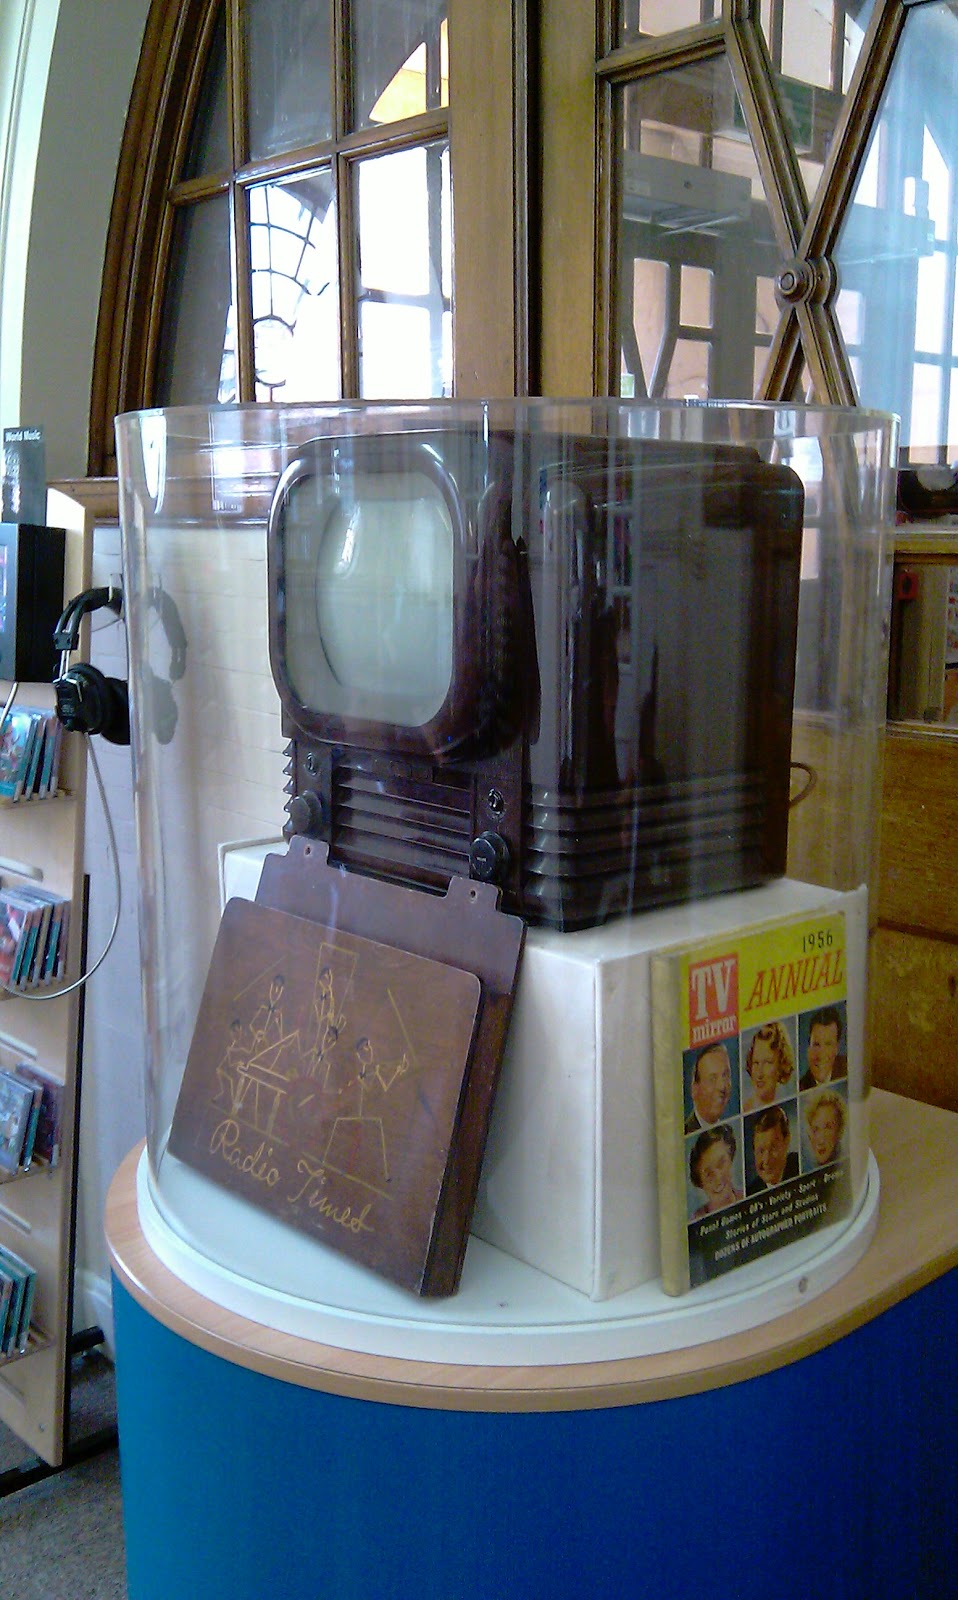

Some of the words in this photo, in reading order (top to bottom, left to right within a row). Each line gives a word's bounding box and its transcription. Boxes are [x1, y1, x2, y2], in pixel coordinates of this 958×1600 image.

[24, 430, 41, 440] Music
[802, 929, 833, 953] 1956
[691, 958, 737, 1020] TV
[744, 949, 844, 1012] ANNUAL
[692, 1014, 737, 1044] mirror
[210, 1119, 281, 1187] Radio
[752, 1217, 760, 1228] of
[781, 1203, 793, 1215] and
[794, 1202, 827, 1224] PORTRAITS
